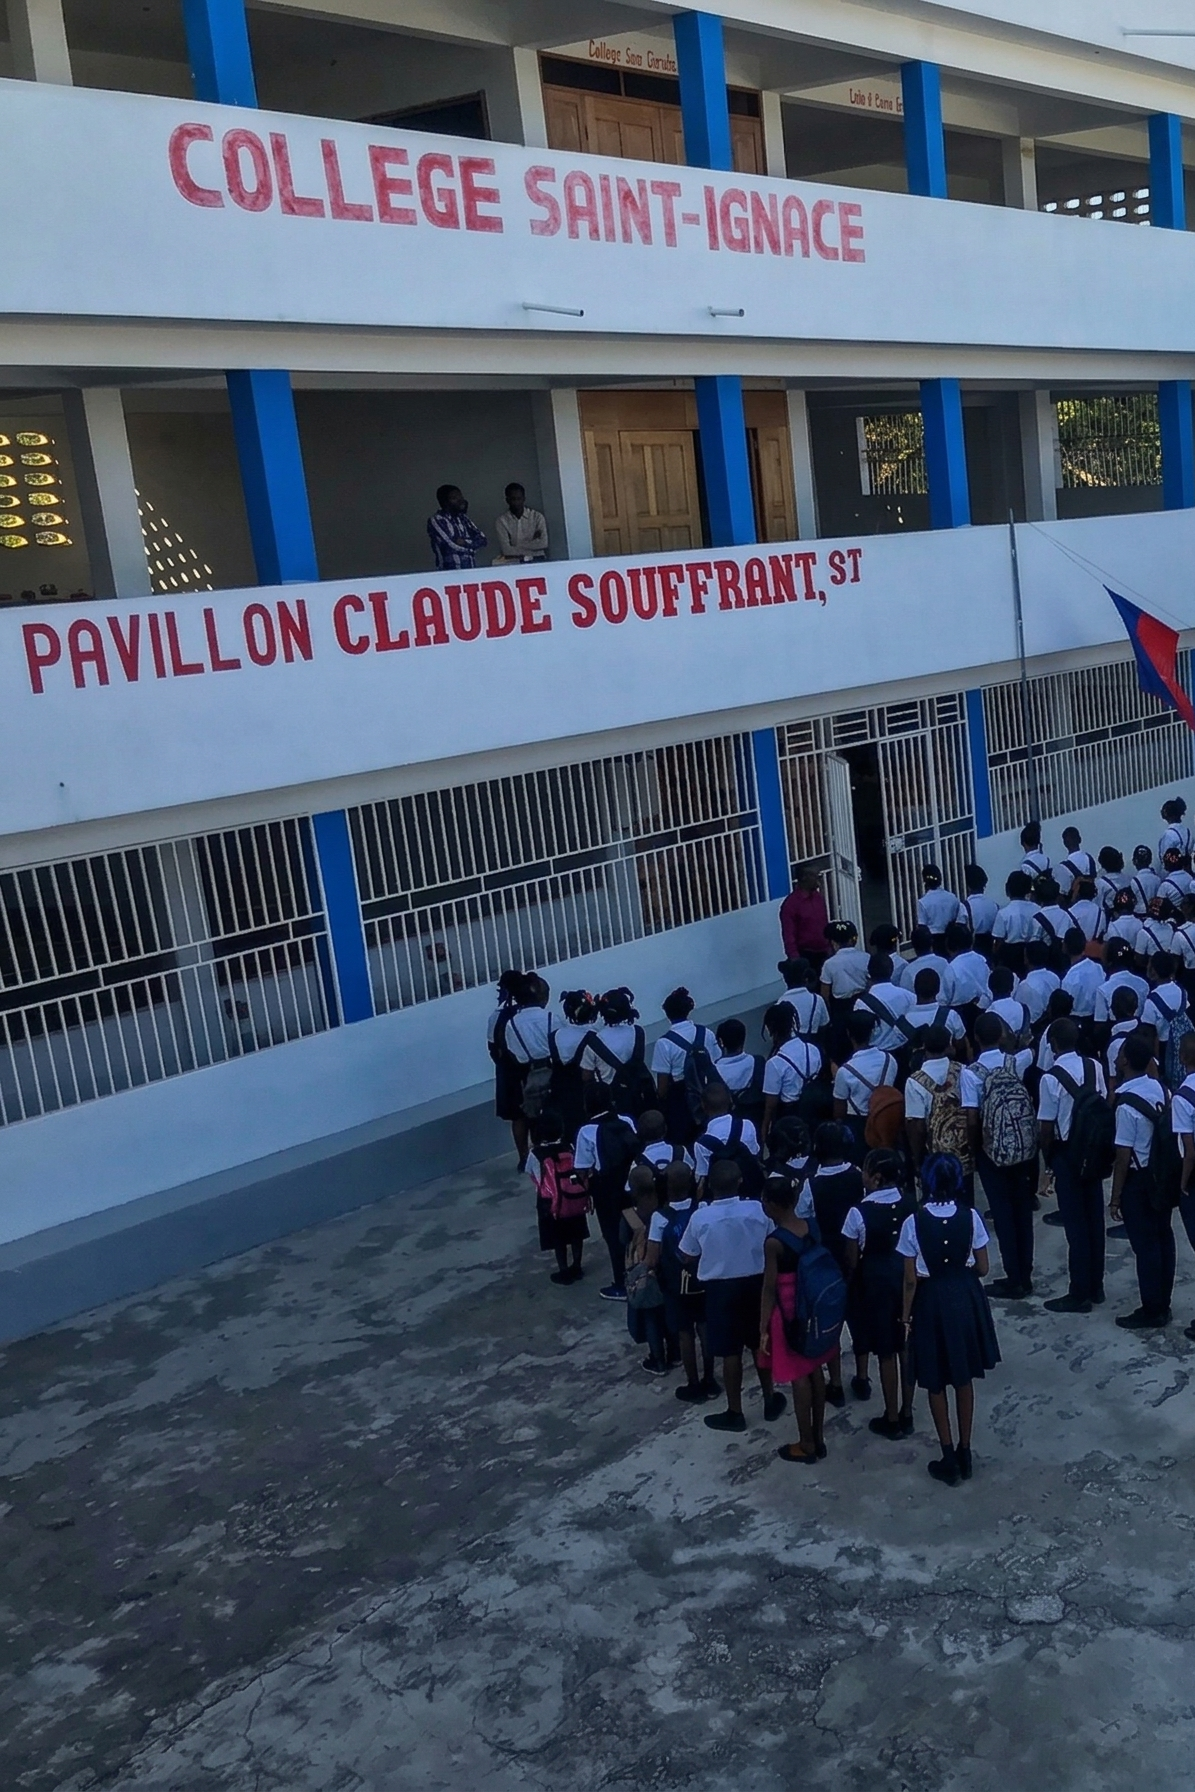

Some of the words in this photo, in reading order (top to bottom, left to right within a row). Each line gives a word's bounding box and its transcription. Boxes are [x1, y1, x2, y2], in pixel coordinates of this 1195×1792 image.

[588, 40, 621, 64] College
[168, 122, 504, 233] COLLEGE
[524, 165, 866, 264] SAINT-IGNACE
[22, 598, 314, 694] PAVILLON
[333, 577, 552, 655] CLAUDE
[828, 547, 863, 585] ST
